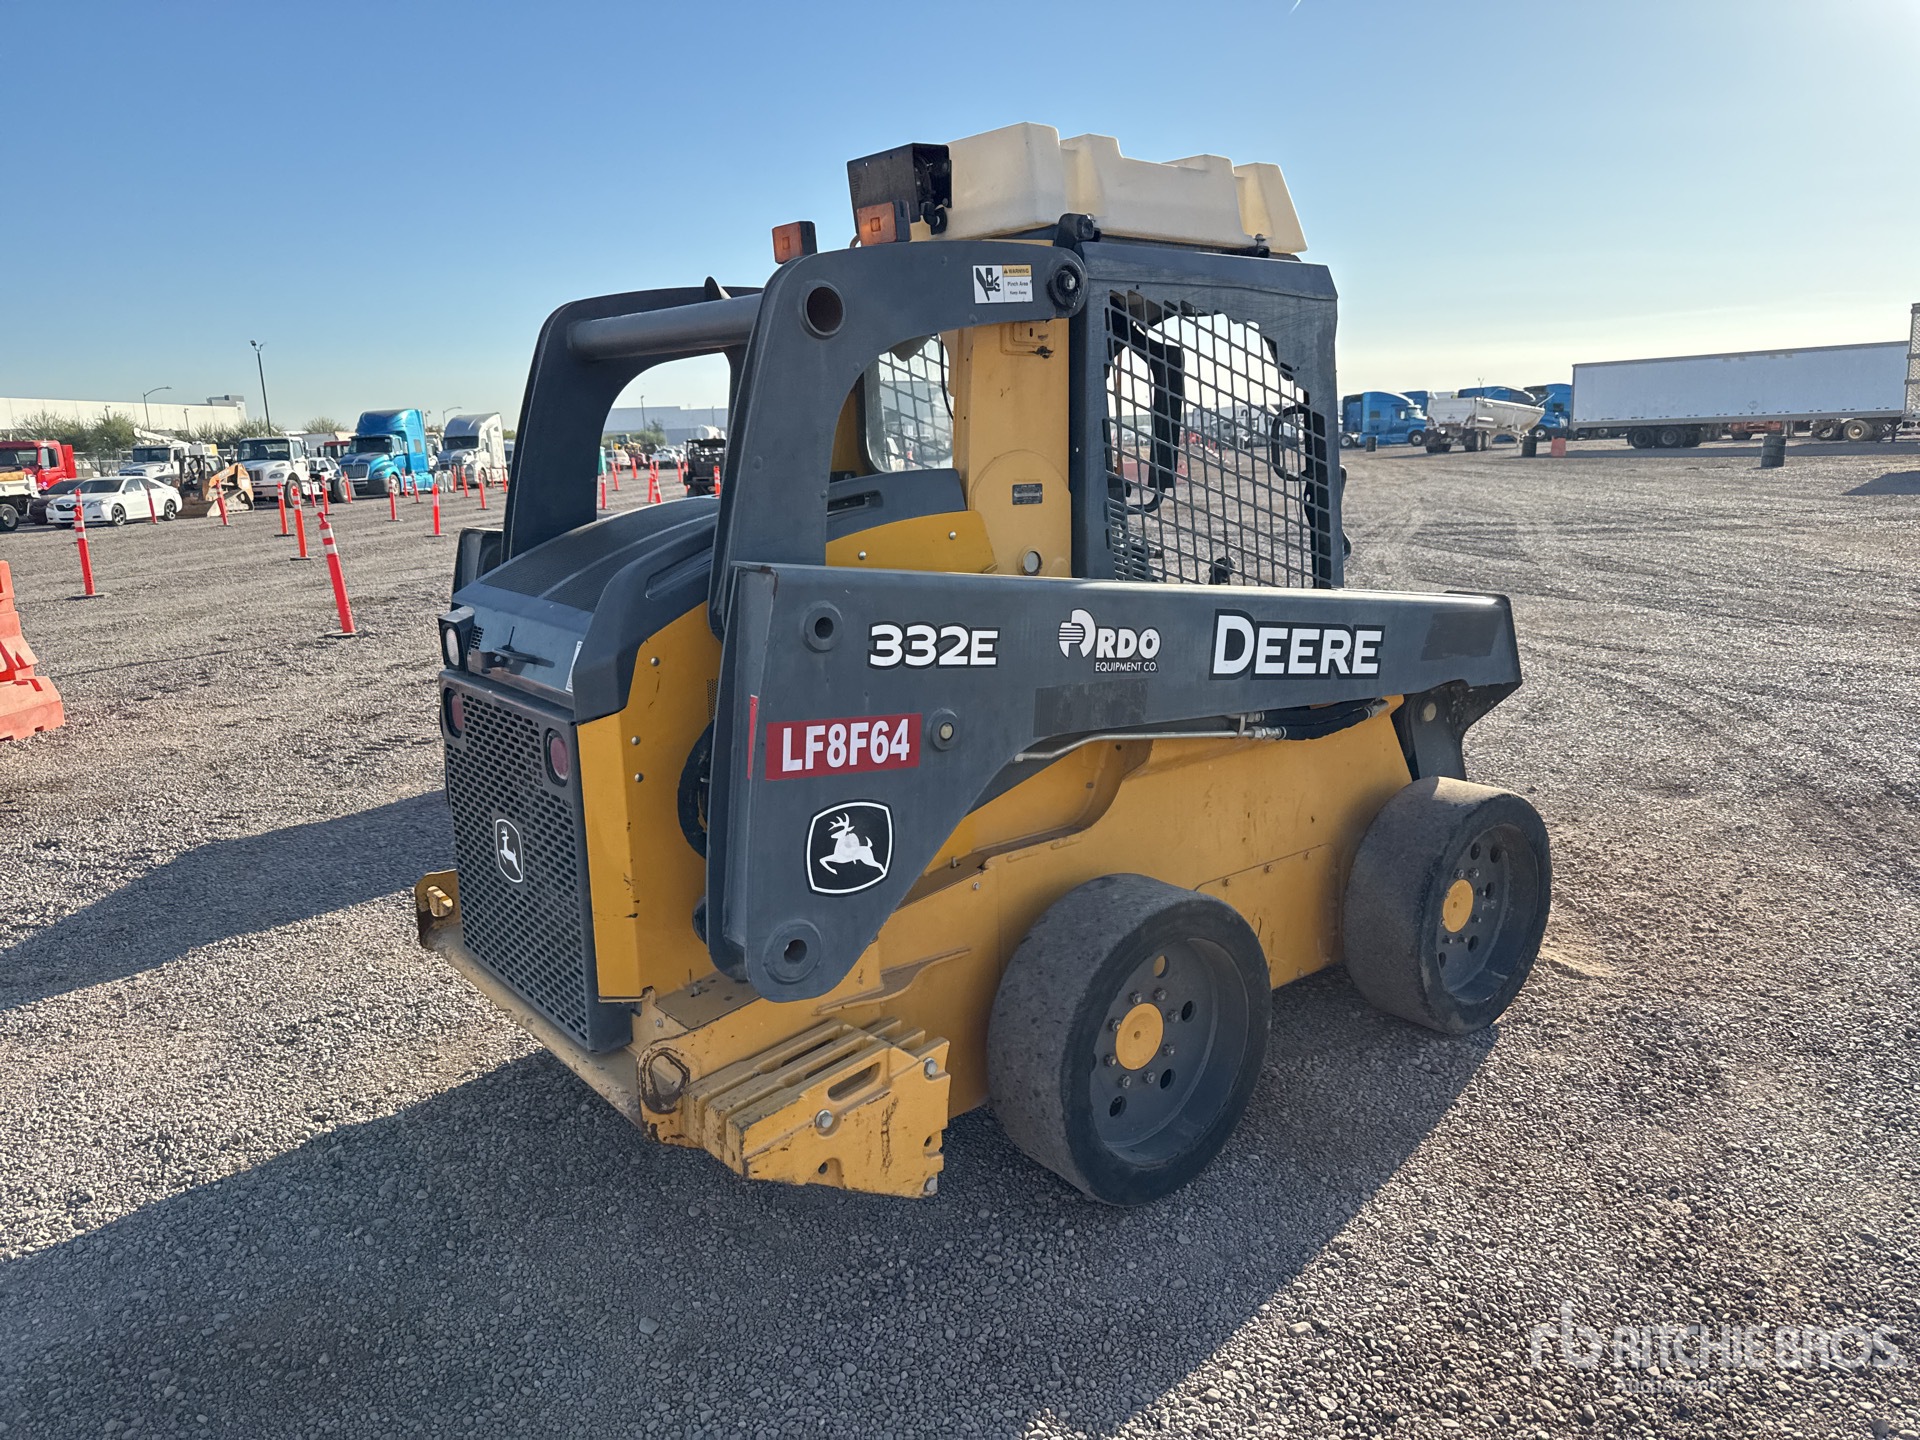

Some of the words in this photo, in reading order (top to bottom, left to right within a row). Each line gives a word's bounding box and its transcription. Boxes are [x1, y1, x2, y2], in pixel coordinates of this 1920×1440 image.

[868, 623, 999, 668] 332E
[1095, 661, 1141, 672] EQUIPMENT
[1143, 661, 1158, 672] CO.
[1213, 614, 1383, 676] DEERE
[781, 718, 910, 772] LF8F64
